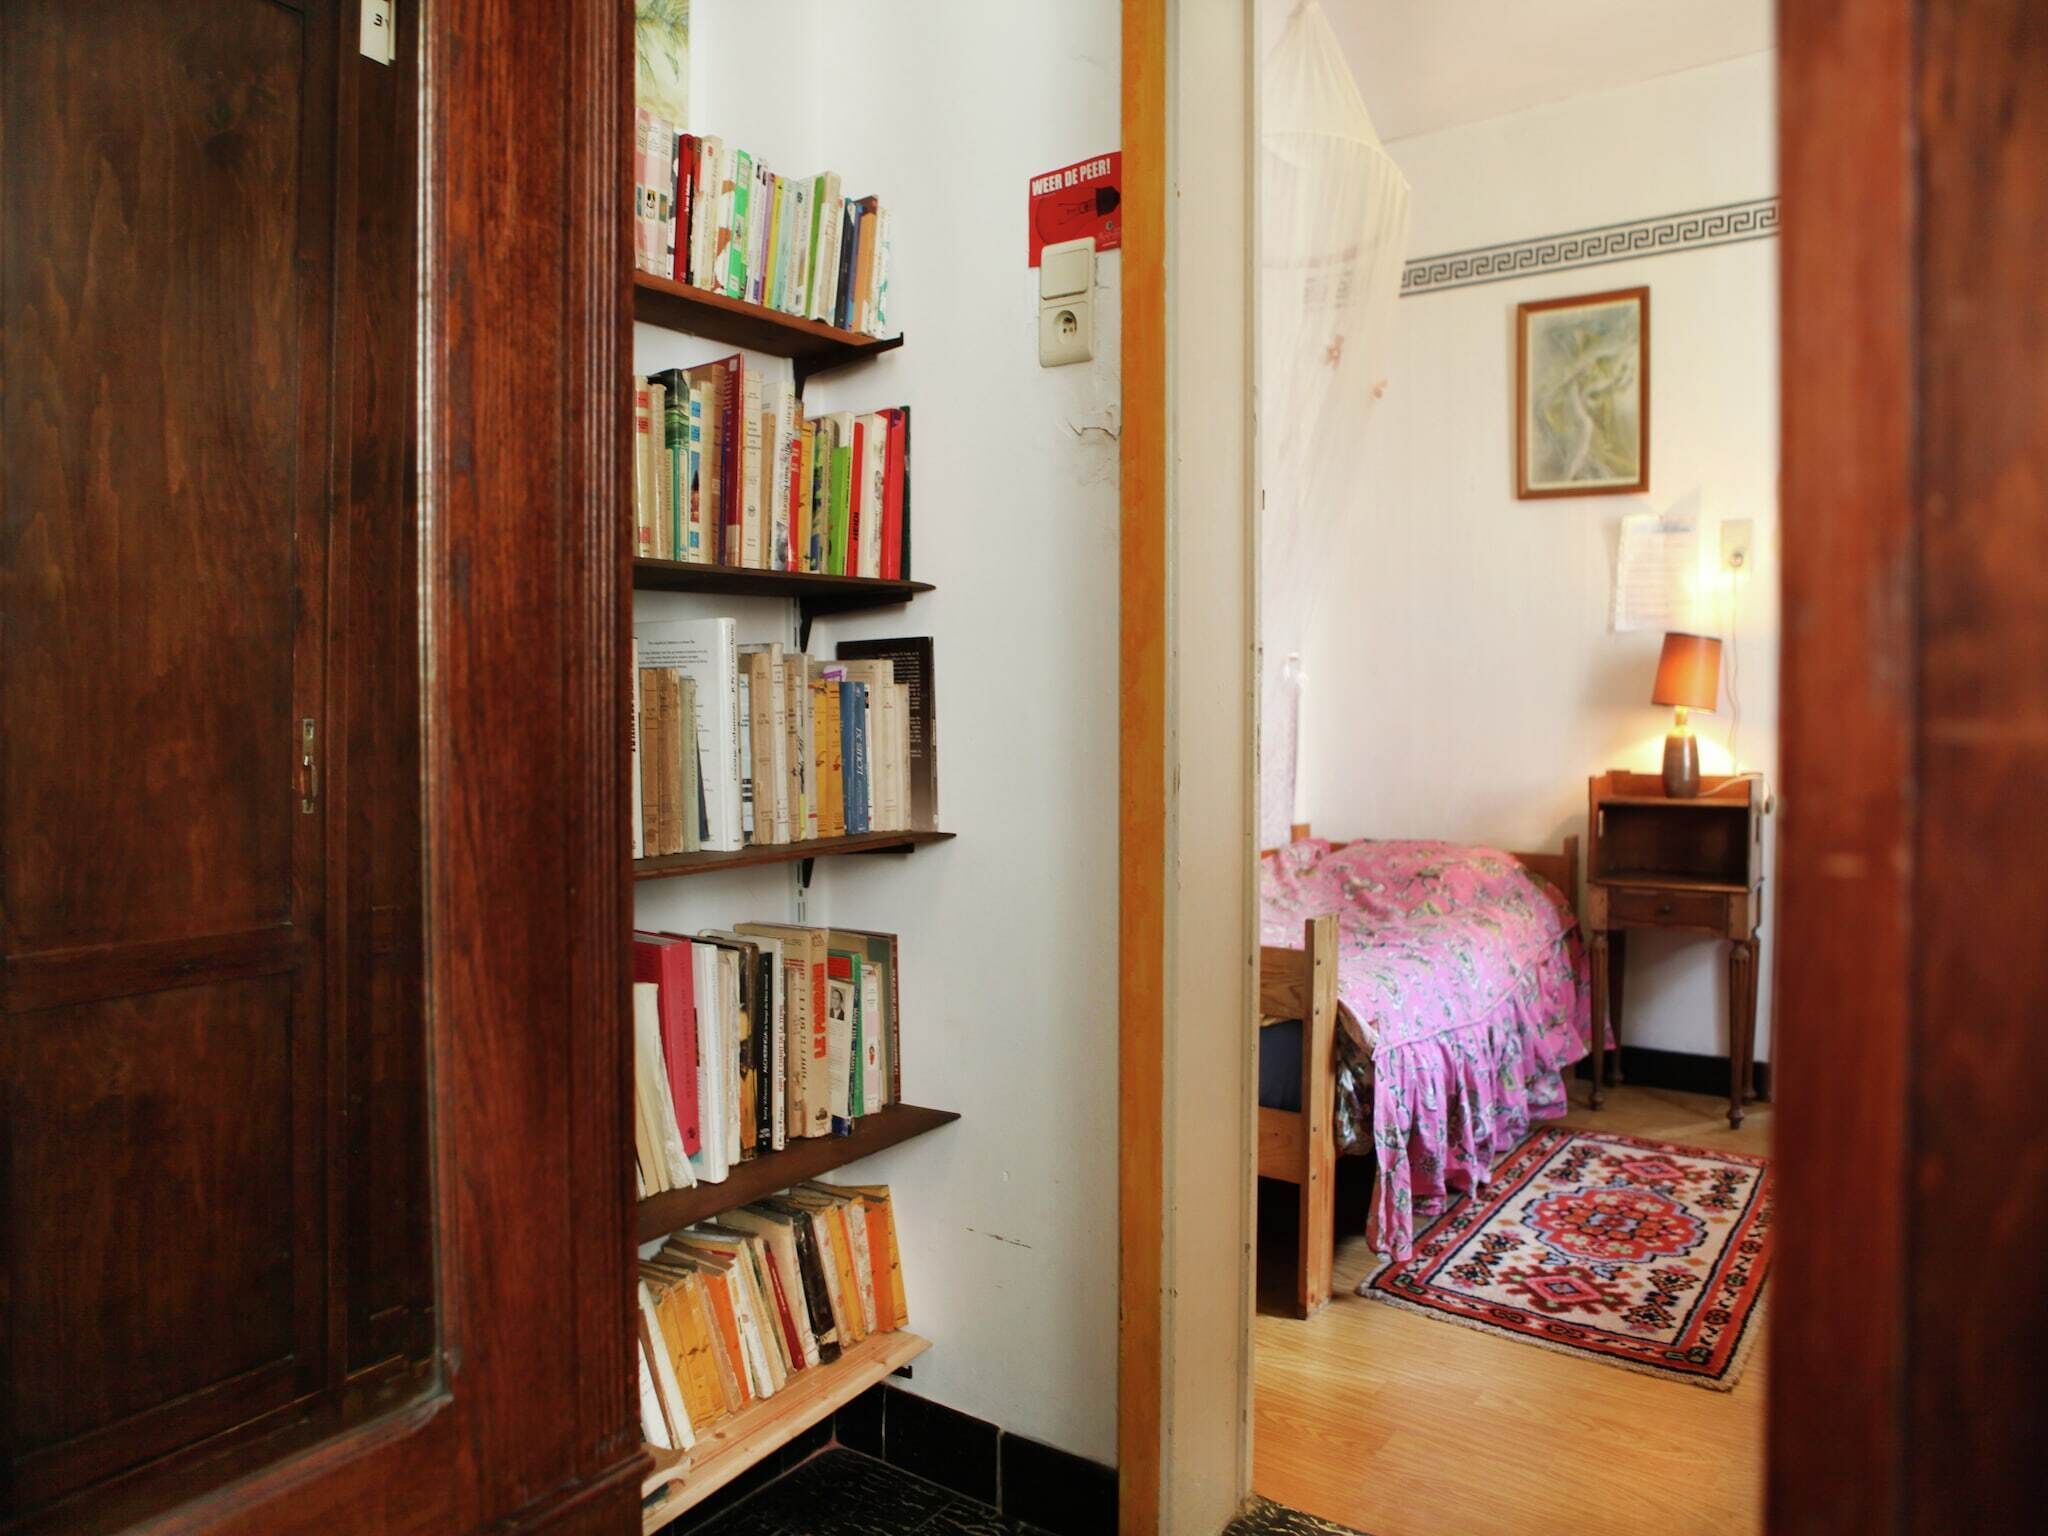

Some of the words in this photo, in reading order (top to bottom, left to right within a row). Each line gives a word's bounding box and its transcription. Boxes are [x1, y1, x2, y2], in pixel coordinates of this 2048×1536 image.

[1032, 174, 1063, 197] WEER
[1064, 168, 1079, 187] DE
[1080, 158, 1111, 182] PEER!
[854, 727, 863, 742] XI
[855, 743, 865, 776] LOUIS
[814, 1036, 827, 1058] LE
